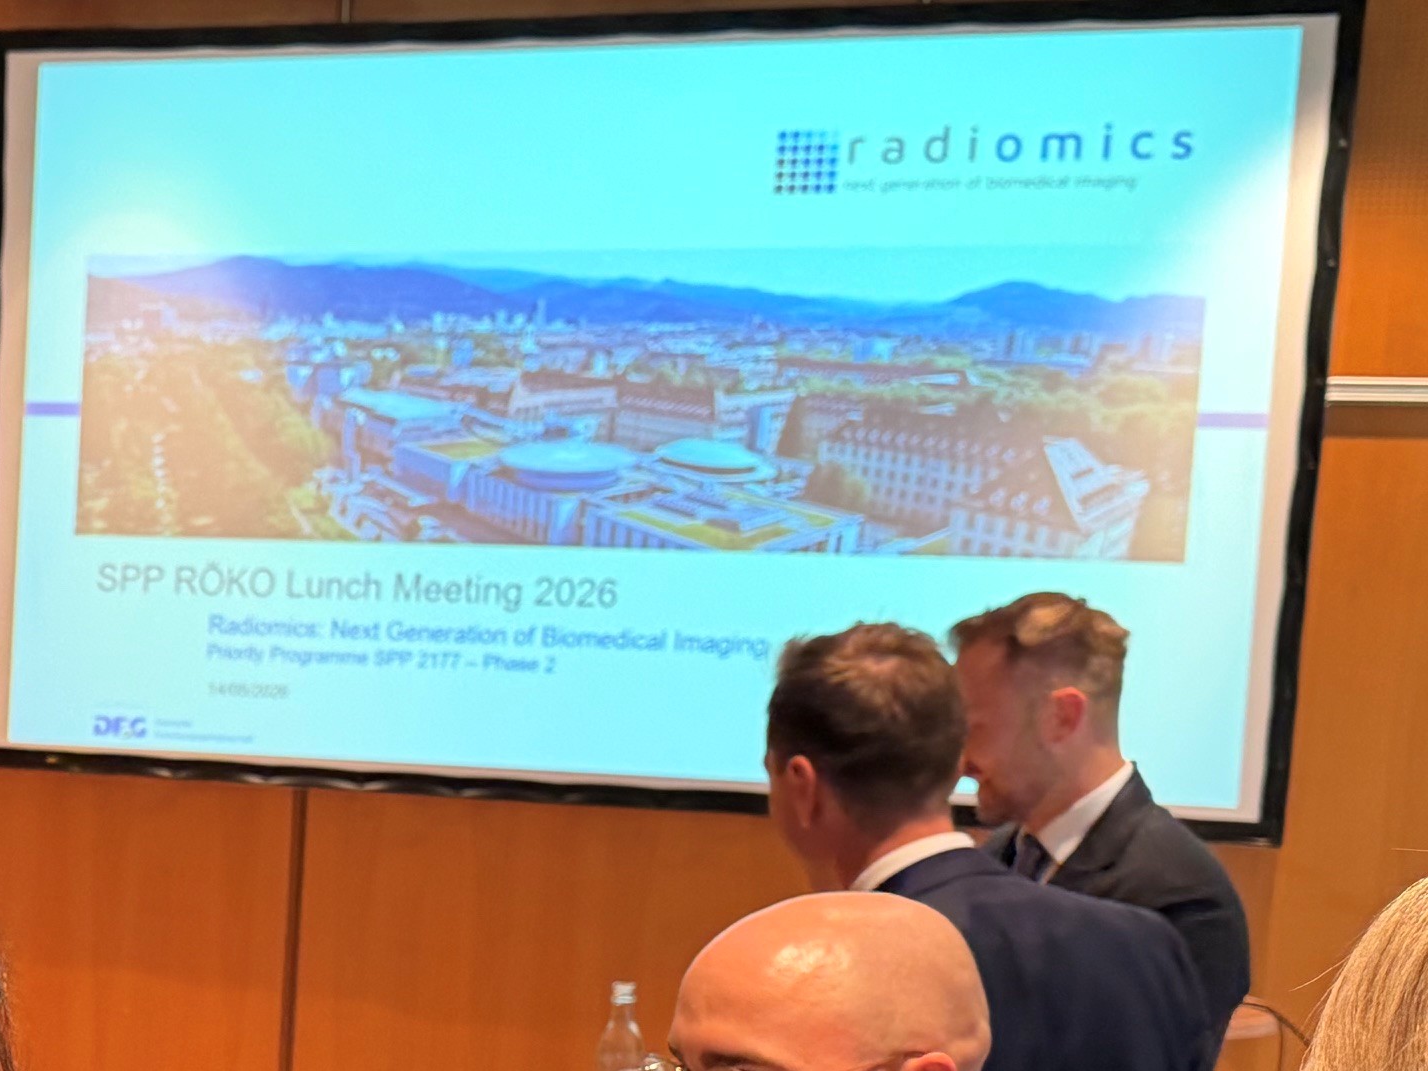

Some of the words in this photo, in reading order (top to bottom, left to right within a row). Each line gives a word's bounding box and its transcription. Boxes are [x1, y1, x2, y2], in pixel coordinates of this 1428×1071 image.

[847, 121, 1194, 165] radiomics
[97, 562, 165, 593] SPP
[173, 561, 276, 598] RÖKO
[285, 568, 382, 600] Lunch
[393, 571, 523, 613] Meeting
[534, 575, 619, 609] 2026
[330, 617, 381, 641] Next
[386, 619, 507, 646] Generation
[513, 624, 536, 646] of
[541, 624, 667, 652] Biomedical
[673, 629, 768, 660] Imaging
[269, 646, 369, 667] Programme
[373, 650, 413, 667] SPP
[418, 651, 461, 670] 2177
[483, 653, 539, 672] Phase
[543, 655, 556, 675] 2
